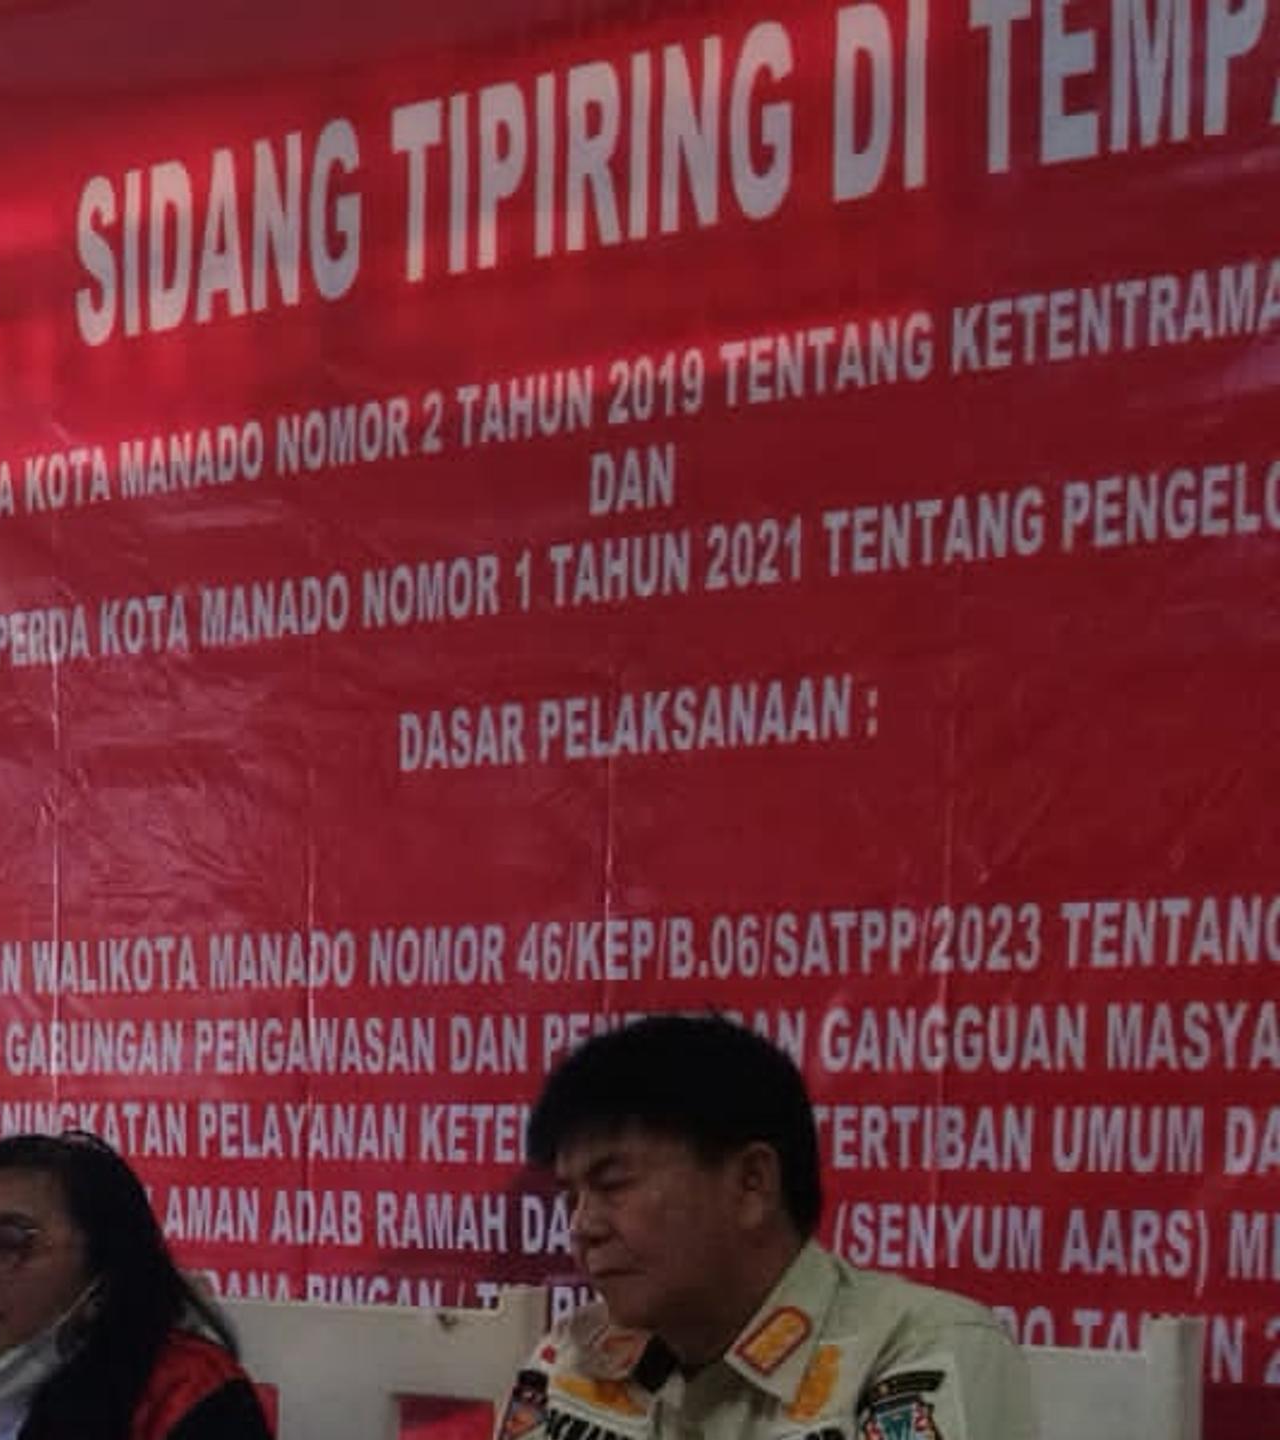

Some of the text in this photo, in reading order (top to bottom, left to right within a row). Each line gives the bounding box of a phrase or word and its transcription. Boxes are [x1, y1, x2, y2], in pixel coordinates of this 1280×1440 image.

[74, 0, 1280, 348] SIDANG TIPIRING DI TEMP
[24, 445, 111, 512] KOTA
[120, 420, 264, 498] MANADO
[276, 400, 408, 476] NOMOR
[421, 400, 442, 456] 2
[457, 366, 594, 448] TAHUN
[607, 349, 704, 425] 2019
[721, 310, 933, 406] TENTANG
[950, 257, 1280, 374] KETENTRAMA
[590, 443, 675, 517] DAN
[99, 595, 188, 658] KOTA
[201, 572, 349, 647] MANADO
[362, 554, 500, 628] NOMOR
[515, 552, 531, 611] 1
[550, 532, 689, 607] TAHUN
[705, 517, 802, 593] 2021
[824, 486, 1041, 578] TENTANG
[399, 700, 525, 773] DASAR
[538, 673, 853, 762] PELAKSANAAN
[31, 935, 197, 996] WALIKOTA
[209, 930, 355, 992] MANADO
[369, 923, 504, 986] NOMOR
[517, 902, 1040, 984] 46/KEP/B.06/SATPP/2023
[5, 1020, 184, 1076] GABUNGAN
[194, 1017, 435, 1076] PENGAWASAN
[449, 1014, 528, 1074] DAN
[819, 1003, 1088, 1073] GANGGUAN
[1105, 1001, 1280, 1073] MASYA
[198, 1102, 403, 1161] PELAYANAN
[1052, 1105, 1205, 1174] UMUM
[270, 1189, 364, 1246] ADAB
[376, 1190, 508, 1254] RAMAH
[521, 1195, 574, 1254] DA
[832, 1202, 1043, 1271] (SENYUM
[1058, 1207, 1209, 1299] AARS)
